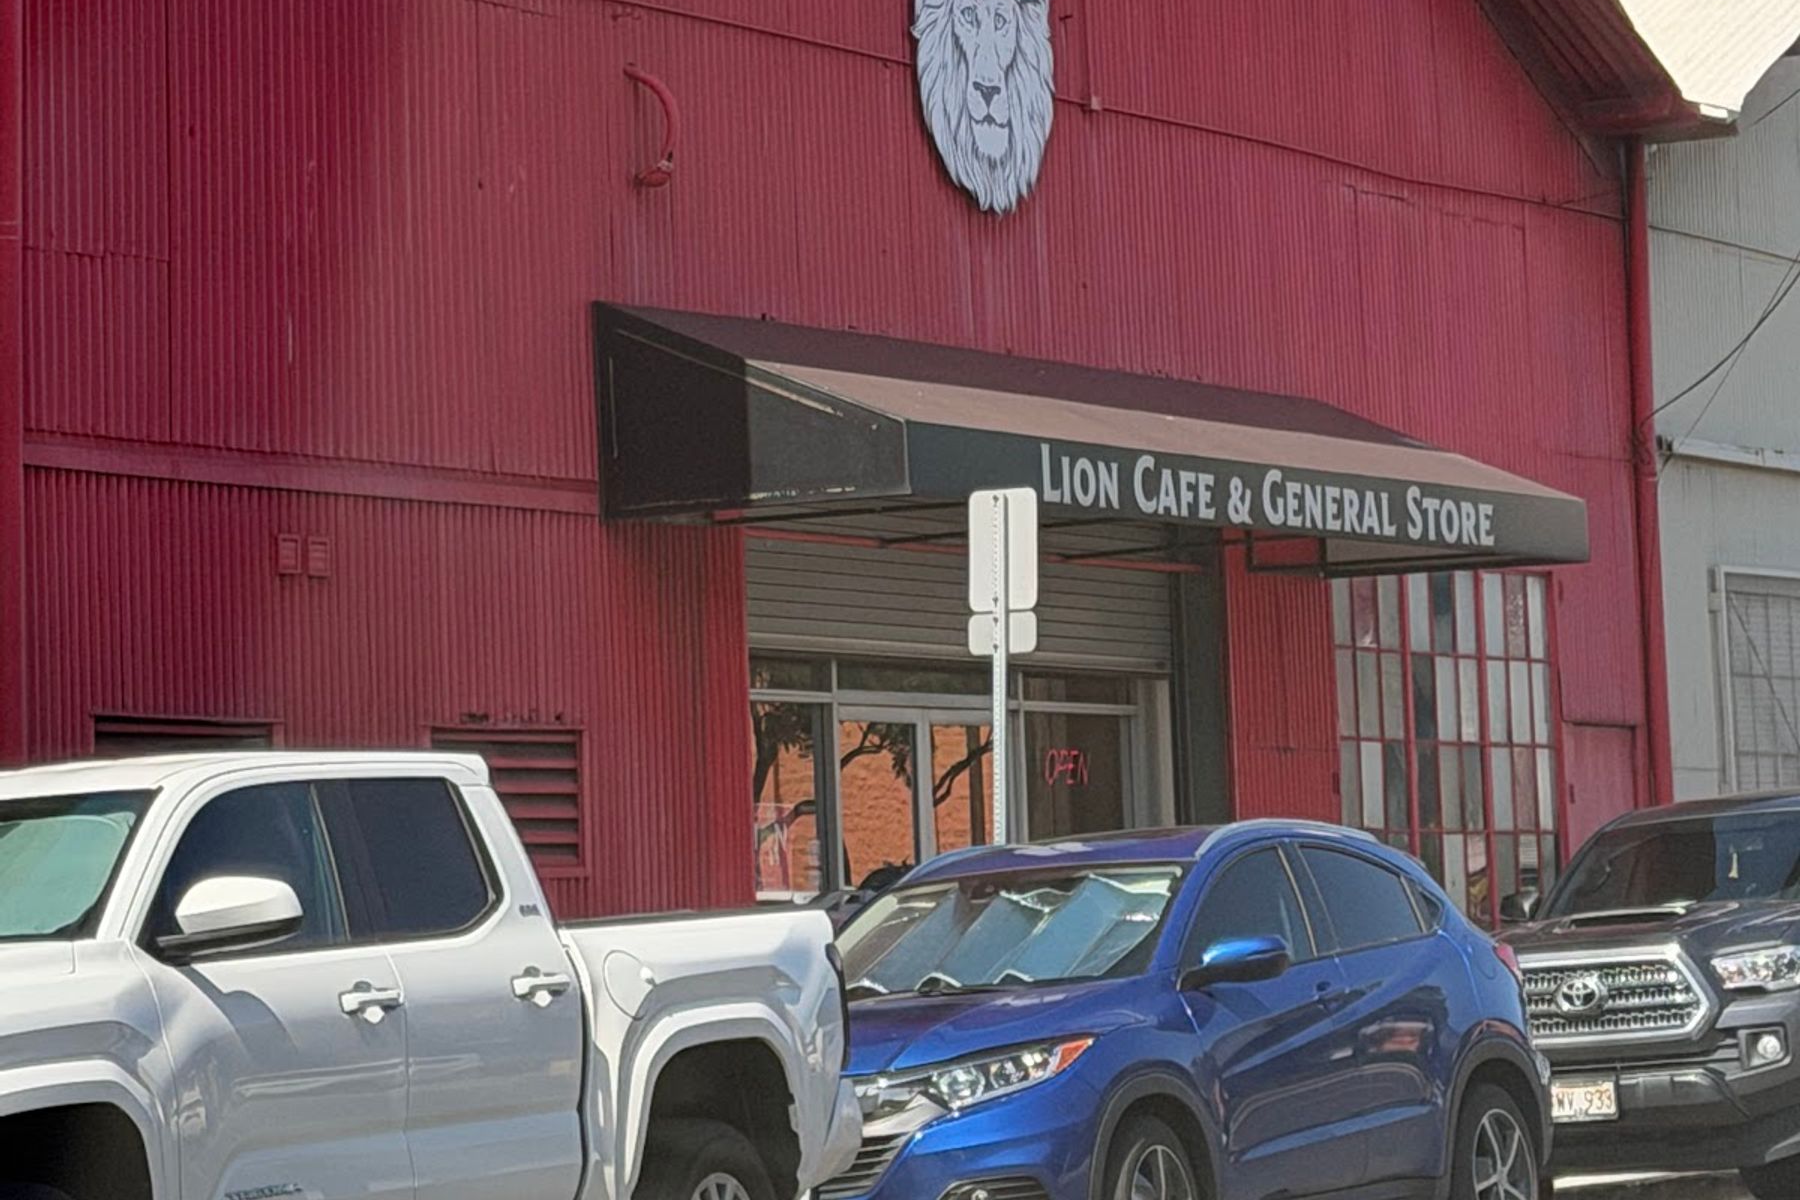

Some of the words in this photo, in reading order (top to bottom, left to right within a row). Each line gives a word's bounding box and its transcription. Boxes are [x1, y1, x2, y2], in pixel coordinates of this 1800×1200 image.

[1040, 443, 1120, 509] LION
[1133, 454, 1217, 520] CAFE
[1227, 476, 1254, 525] &
[1262, 468, 1397, 538] GENERAL
[1406, 485, 1495, 546] STORE
[1044, 749, 1089, 787] OPEN
